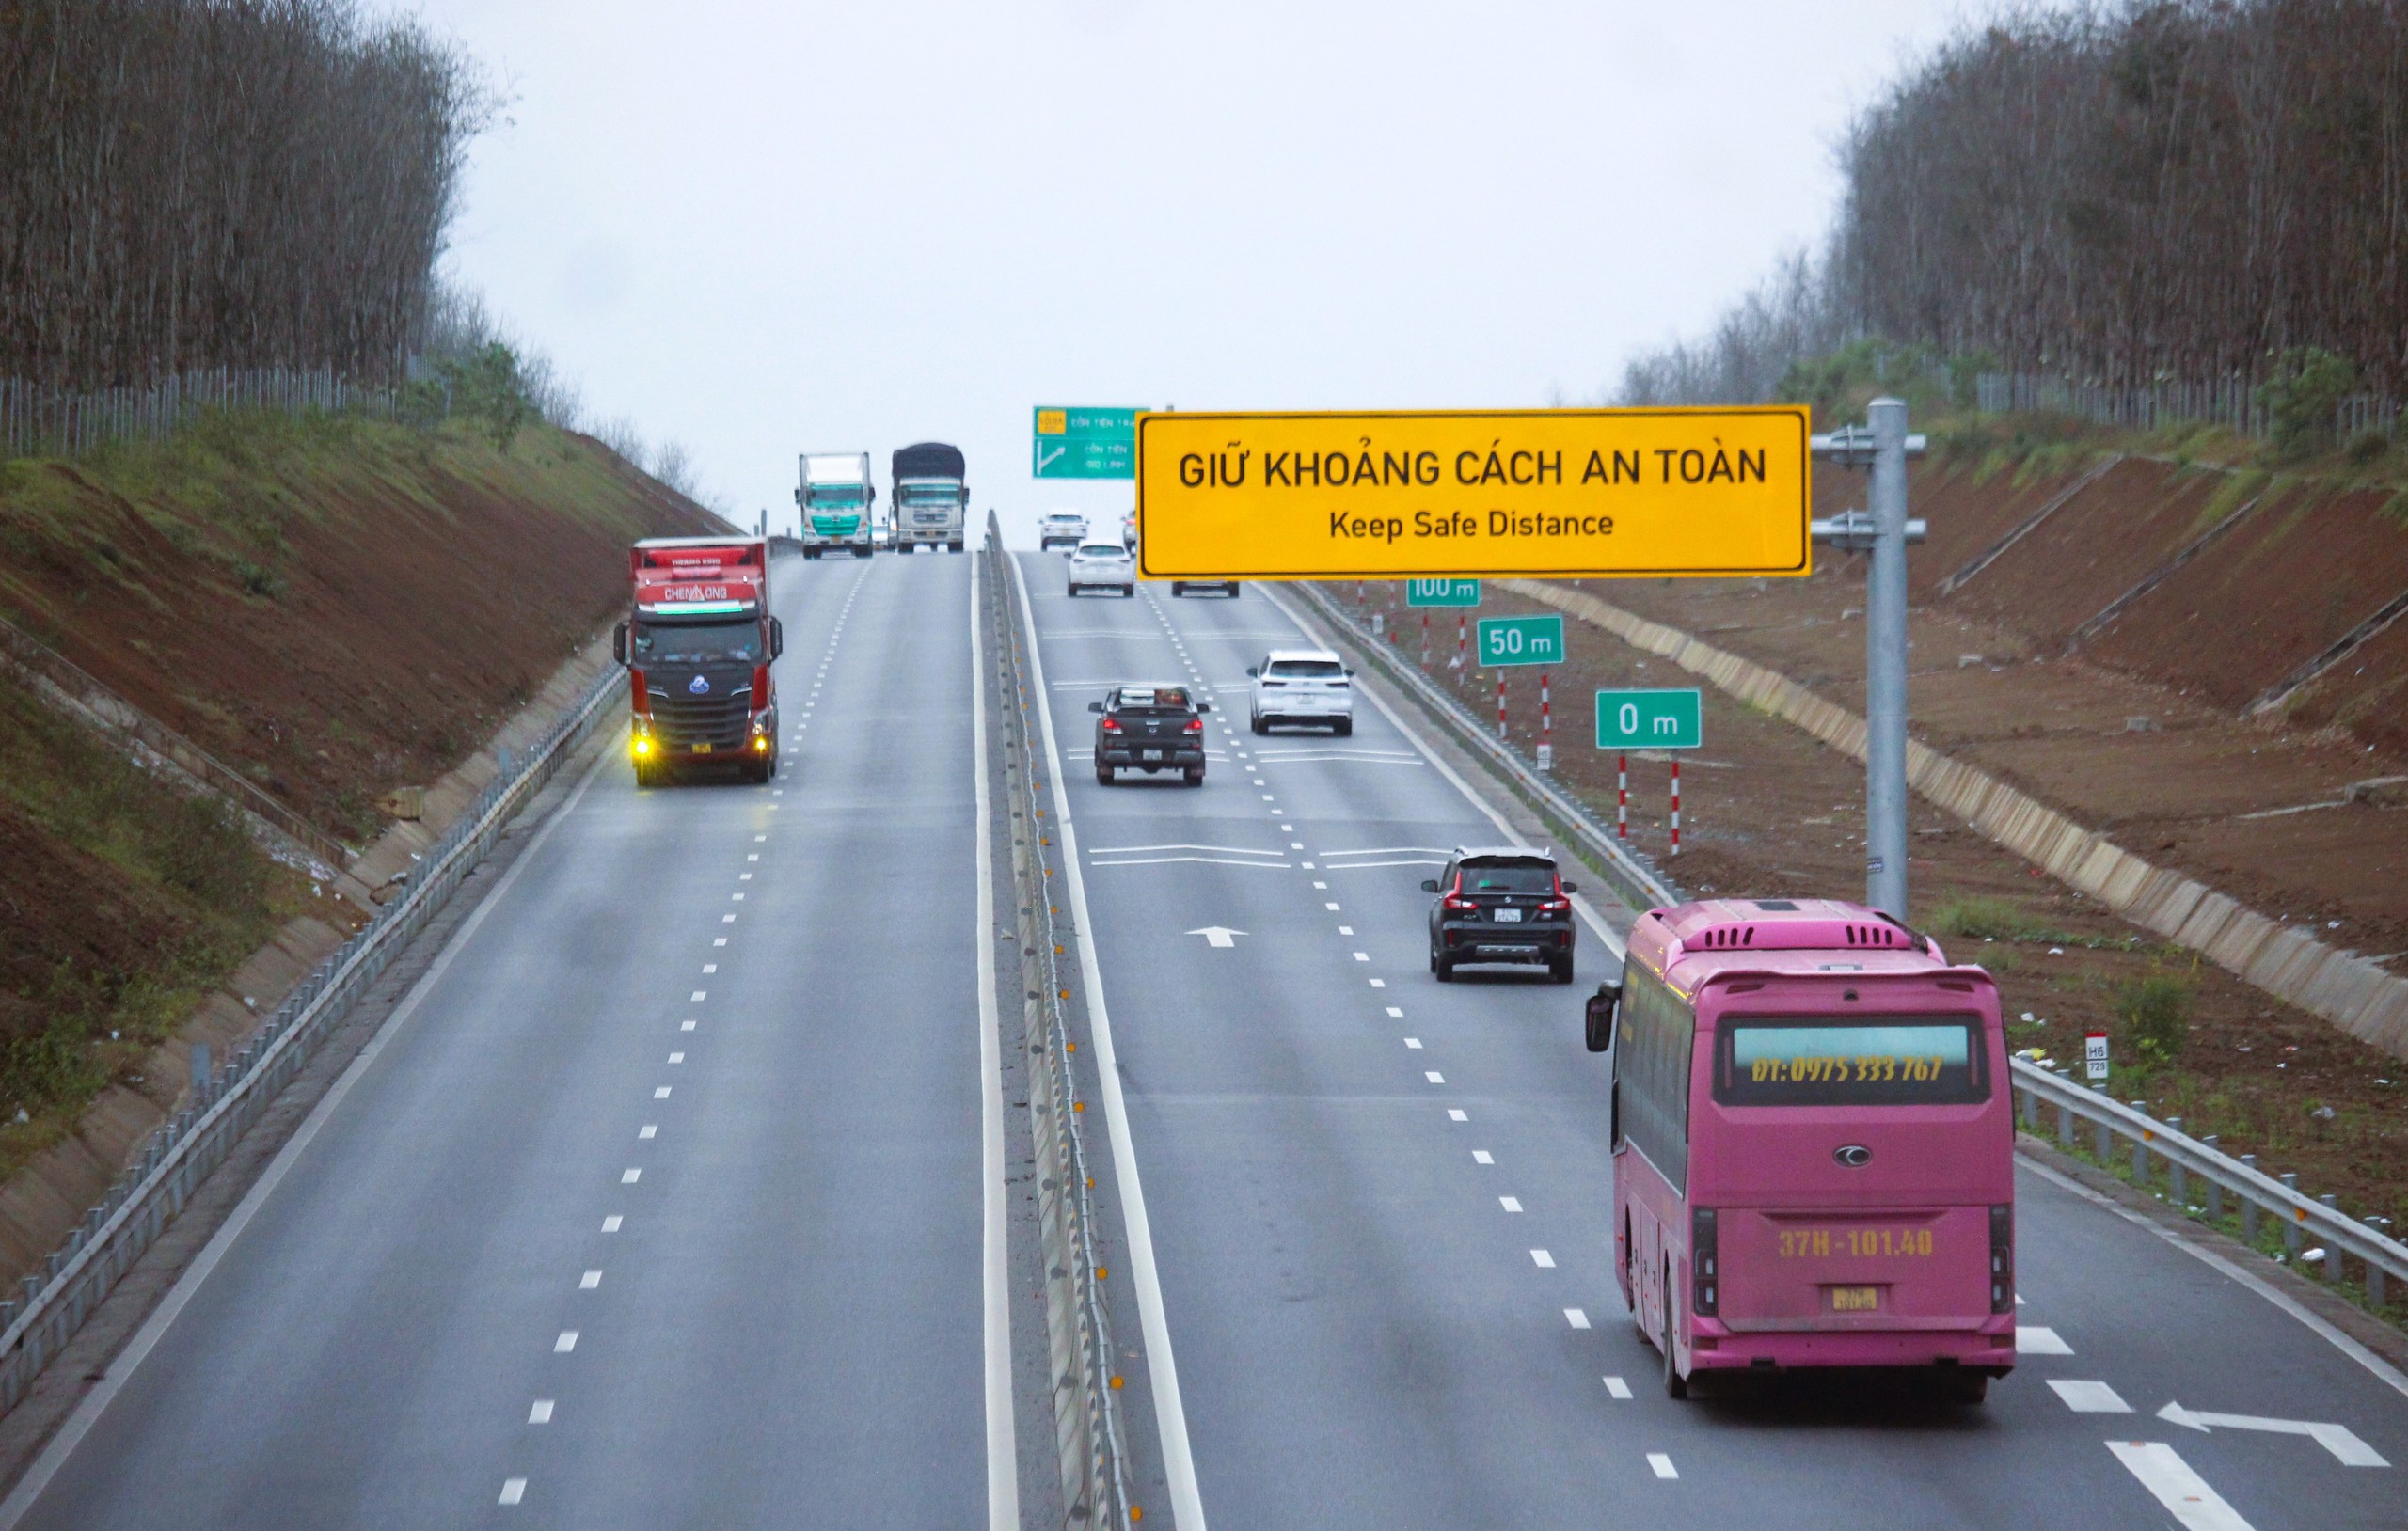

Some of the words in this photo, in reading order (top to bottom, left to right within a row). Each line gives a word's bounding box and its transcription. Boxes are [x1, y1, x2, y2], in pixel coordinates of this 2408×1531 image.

[1180, 441, 1250, 487] GIỮ
[1264, 436, 1440, 487] KHOẢNG
[1455, 439, 1562, 486] CÁCH
[1581, 450, 1640, 485] AN
[1654, 437, 1766, 484] TOÀN
[1329, 512, 1402, 545] Keep
[1414, 511, 1477, 538] Safe
[1489, 510, 1613, 536] Distance
[1416, 579, 1450, 597] 100
[1456, 584, 1474, 597] m
[1490, 628, 1522, 655] 50
[1531, 638, 1551, 653] m
[1619, 703, 1638, 735] 0
[1653, 716, 1678, 734] m
[2088, 1046, 2104, 1057] H6
[1855, 1056, 1895, 1081] 333
[1902, 1056, 1943, 1081] 767
